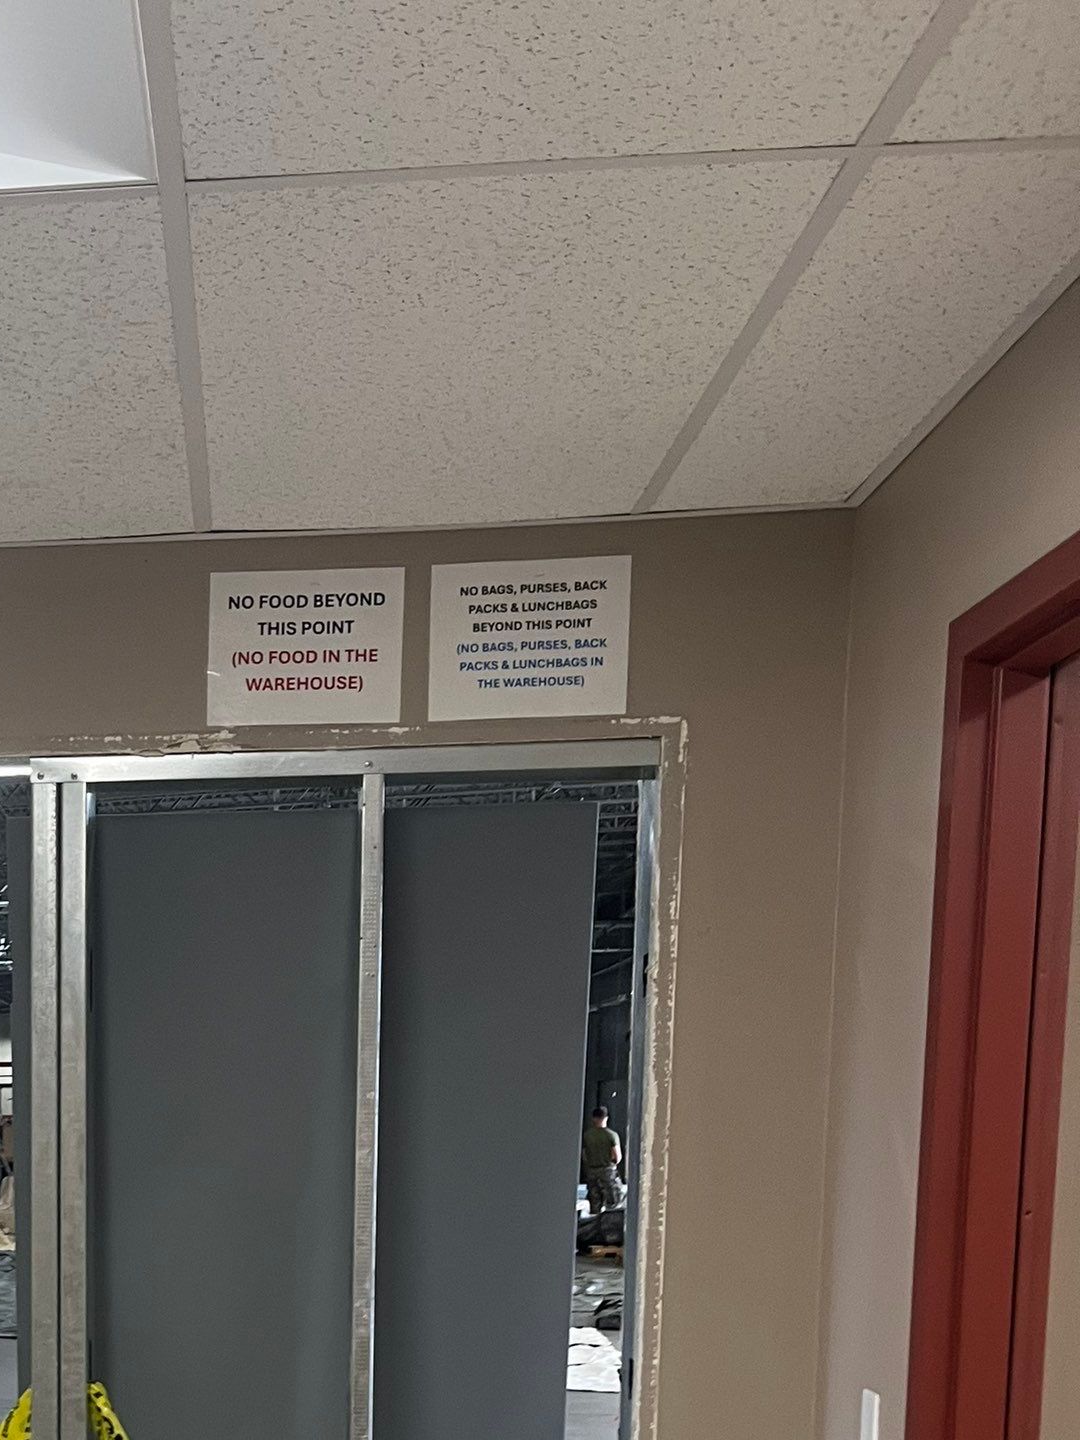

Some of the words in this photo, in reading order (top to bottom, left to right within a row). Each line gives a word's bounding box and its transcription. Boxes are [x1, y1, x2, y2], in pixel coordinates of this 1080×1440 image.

[459, 586, 479, 597] NO
[480, 583, 519, 597] BAGS,
[519, 580, 572, 596] PURSES,
[574, 579, 608, 592] BACK
[228, 595, 255, 610] NO
[258, 594, 309, 610] FOOD
[313, 592, 386, 608] BEYOND
[468, 602, 508, 615] PACKS
[510, 602, 520, 613] &
[521, 598, 598, 613] LUNCHBAGS
[257, 621, 297, 636] THIS
[301, 619, 355, 636] POINT
[472, 620, 523, 633] BEYOND
[524, 619, 553, 631] THIS
[555, 617, 593, 630] POINT
[455, 641, 478, 657] (NO
[480, 640, 519, 655] BAGS,
[519, 639, 573, 653] PURSES,
[574, 637, 608, 649] BACK
[231, 651, 264, 669] (NO
[268, 650, 318, 665] FOOD
[322, 649, 341, 664] IN
[344, 648, 379, 663] THE
[459, 660, 499, 672] PACKS
[501, 660, 510, 670] &
[512, 656, 588, 670] LUNCHBAGS
[590, 656, 604, 667] IN
[245, 675, 364, 693] WAREHOUSE)
[477, 678, 501, 689] THE
[502, 675, 585, 688] WAREHOUSE)
